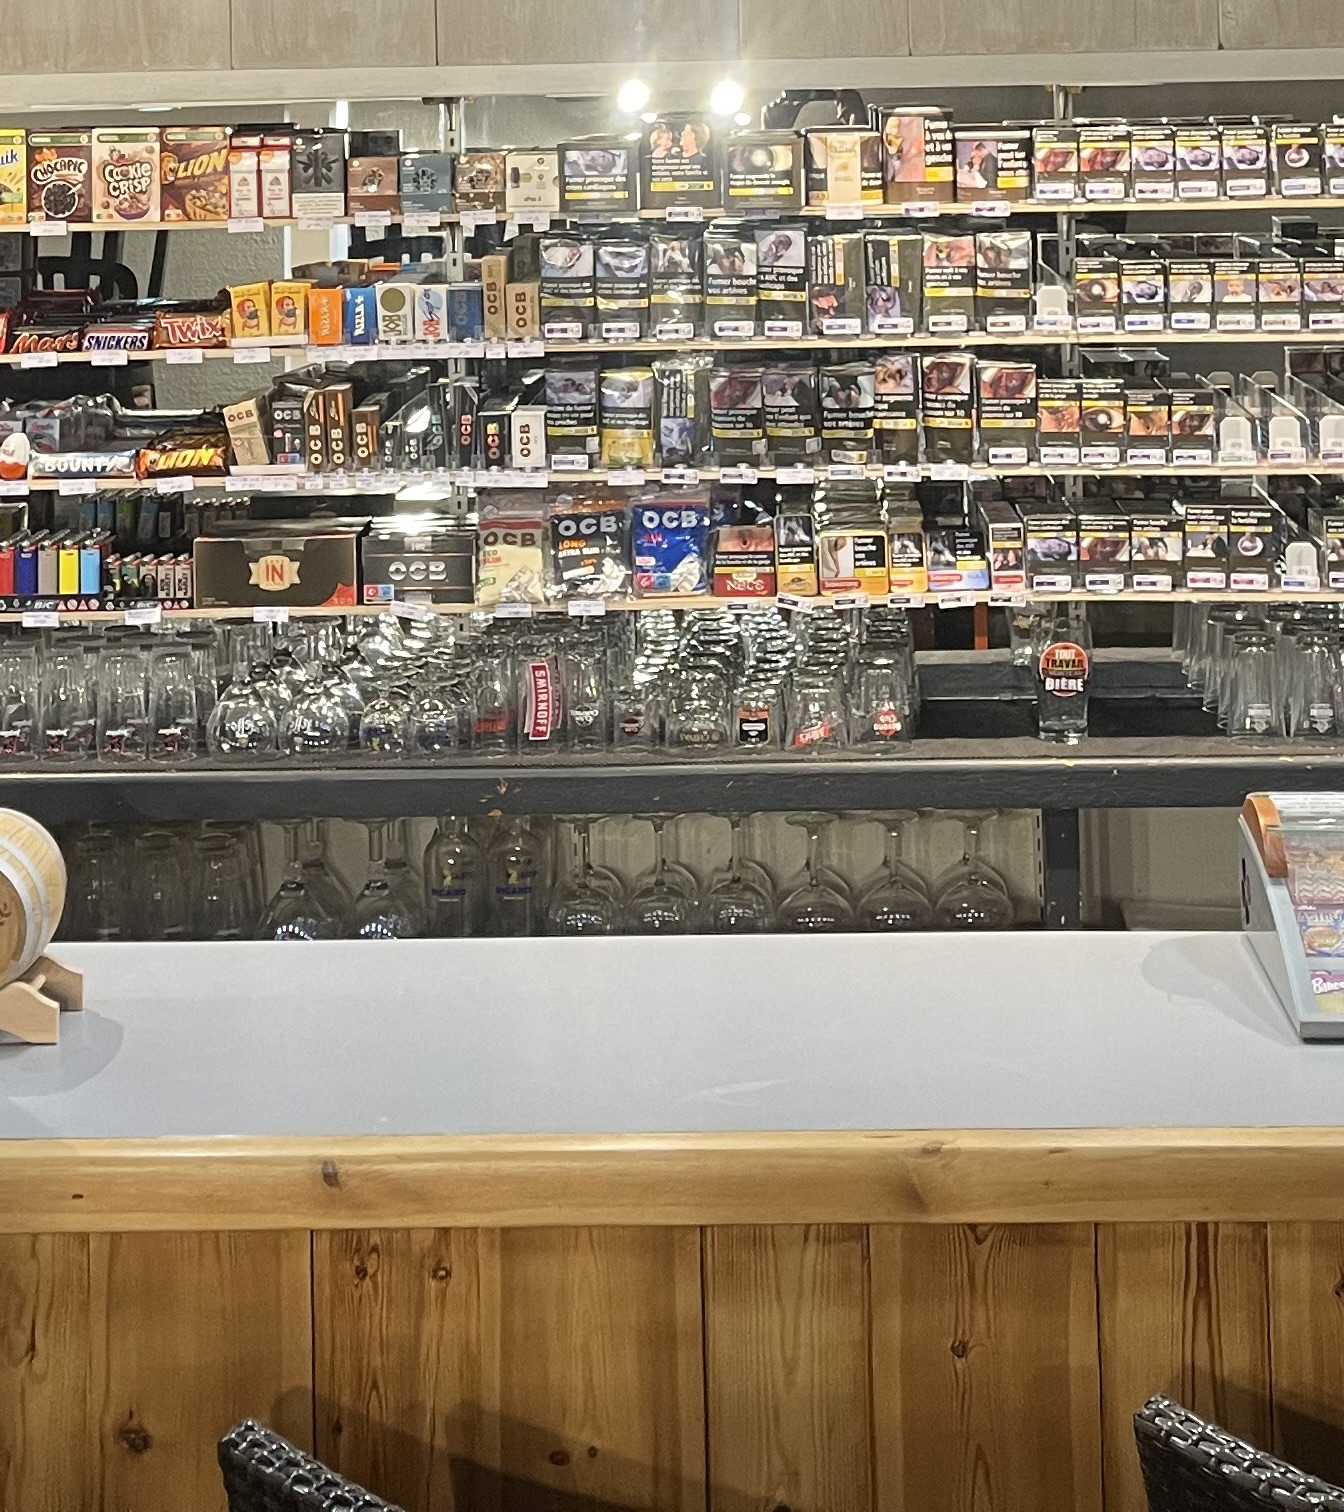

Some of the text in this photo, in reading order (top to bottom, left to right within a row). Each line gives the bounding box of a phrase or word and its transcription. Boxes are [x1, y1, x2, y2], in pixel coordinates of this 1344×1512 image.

[32, 158, 87, 183] CHOCAPIC
[176, 146, 227, 179] LION
[486, 281, 498, 315] OCB
[515, 291, 527, 328] OCB
[9, 331, 79, 353] Mars
[84, 335, 147, 350] SNICKERS
[227, 409, 254, 422] OCB
[273, 410, 301, 420] OCB
[309, 424, 322, 464] OCB
[330, 428, 344, 464] OCB
[355, 422, 368, 458] OCB
[519, 423, 531, 457] OCB
[44, 455, 117, 472] BOUNTY
[156, 444, 215, 469] LION
[558, 515, 618, 537] OCB
[642, 510, 698, 529] OCB
[483, 531, 536, 547] OCB
[558, 539, 587, 549] LONG
[264, 563, 284, 583] IN
[388, 560, 447, 581] OCB
[1055, 649, 1076, 659] TOUT
[1045, 677, 1083, 691] BIÈRE
[534, 669, 546, 733] SMIRNOFF
